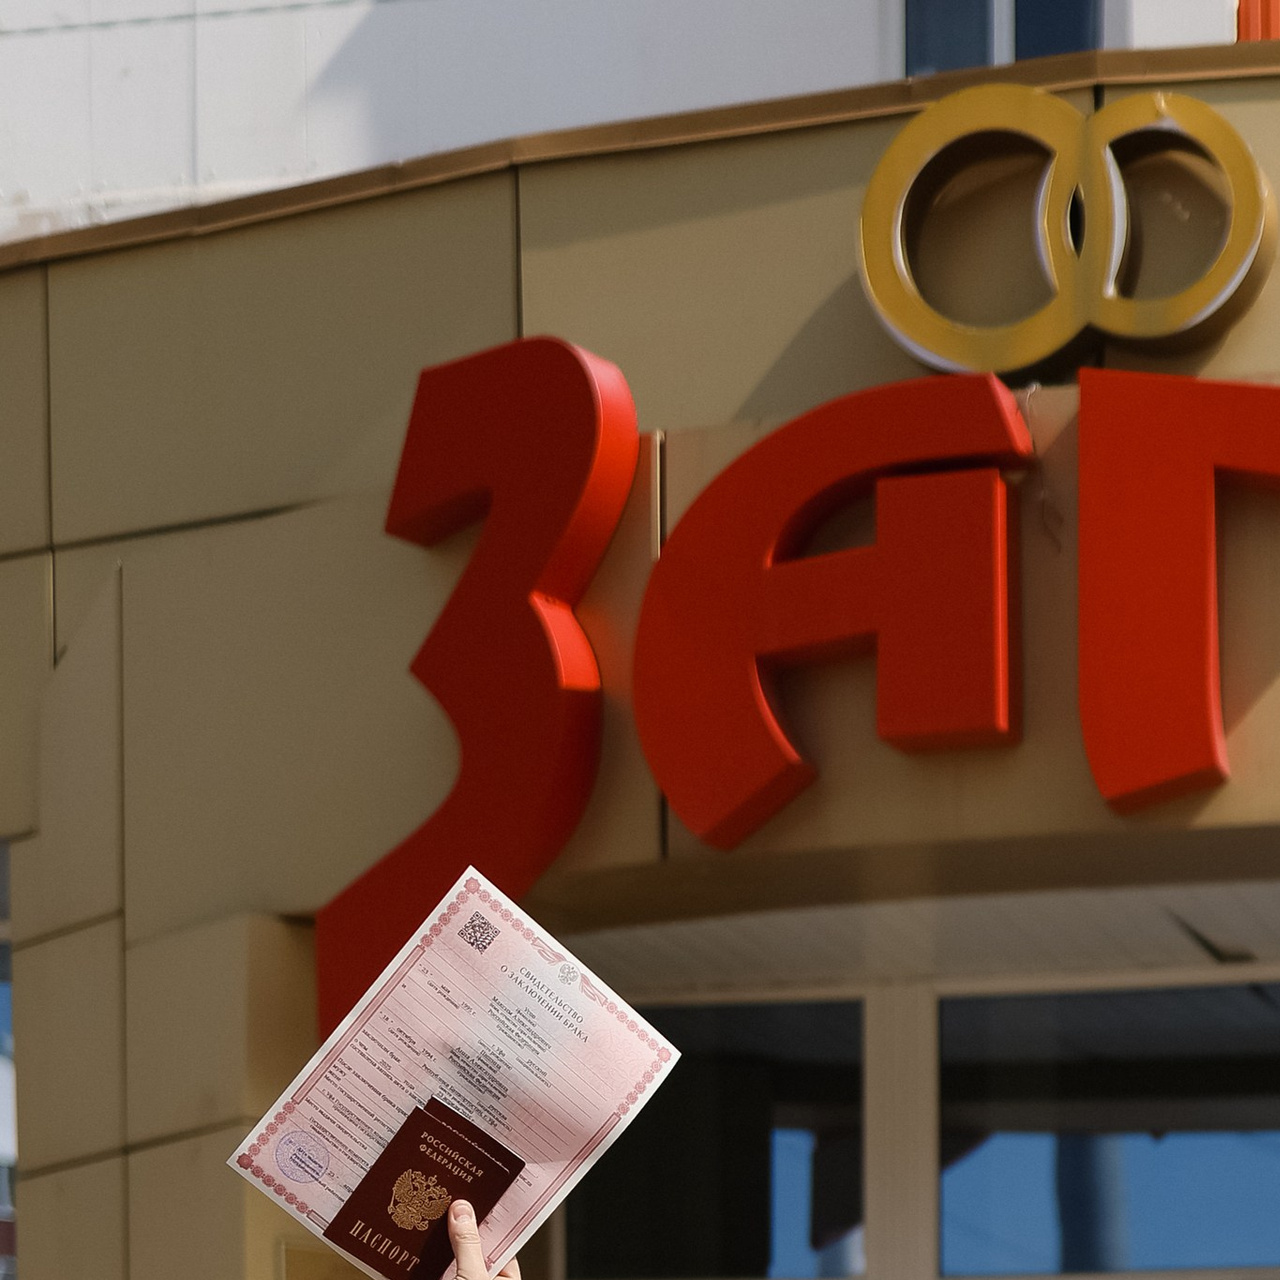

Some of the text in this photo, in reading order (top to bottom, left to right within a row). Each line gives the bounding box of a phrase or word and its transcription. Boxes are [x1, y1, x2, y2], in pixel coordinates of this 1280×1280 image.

[499, 964, 589, 1043] О ЗАКЛЮЧЕНИИ БРАКА
[518, 966, 584, 1024] СВИДЕТЕЛЬСТВО
[395, 1026, 417, 1046] октября
[487, 1008, 540, 1055] Российская Федерация
[491, 996, 552, 1050] Максим Александрович
[357, 1041, 368, 1051] чем
[403, 1079, 415, 1090] года
[361, 1028, 401, 1064] заключили брак
[494, 1046, 506, 1058] Уфа
[327, 1069, 341, 1082] жене
[331, 1063, 347, 1077] мужу
[337, 1057, 353, 1071] После
[351, 1069, 382, 1096] заключения
[380, 1093, 397, 1108] брака
[392, 1079, 405, 1090] акта
[526, 1058, 547, 1078] русский
[304, 1096, 320, 1110] Место
[323, 1074, 338, 1088] Место
[336, 1085, 375, 1119] государственной
[417, 1142, 473, 1184] ФЕДЕРАЦИЯ
[420, 1131, 484, 1177] РОССИЙСКАЯ
[348, 1219, 420, 1273] ПАСПОРТ
